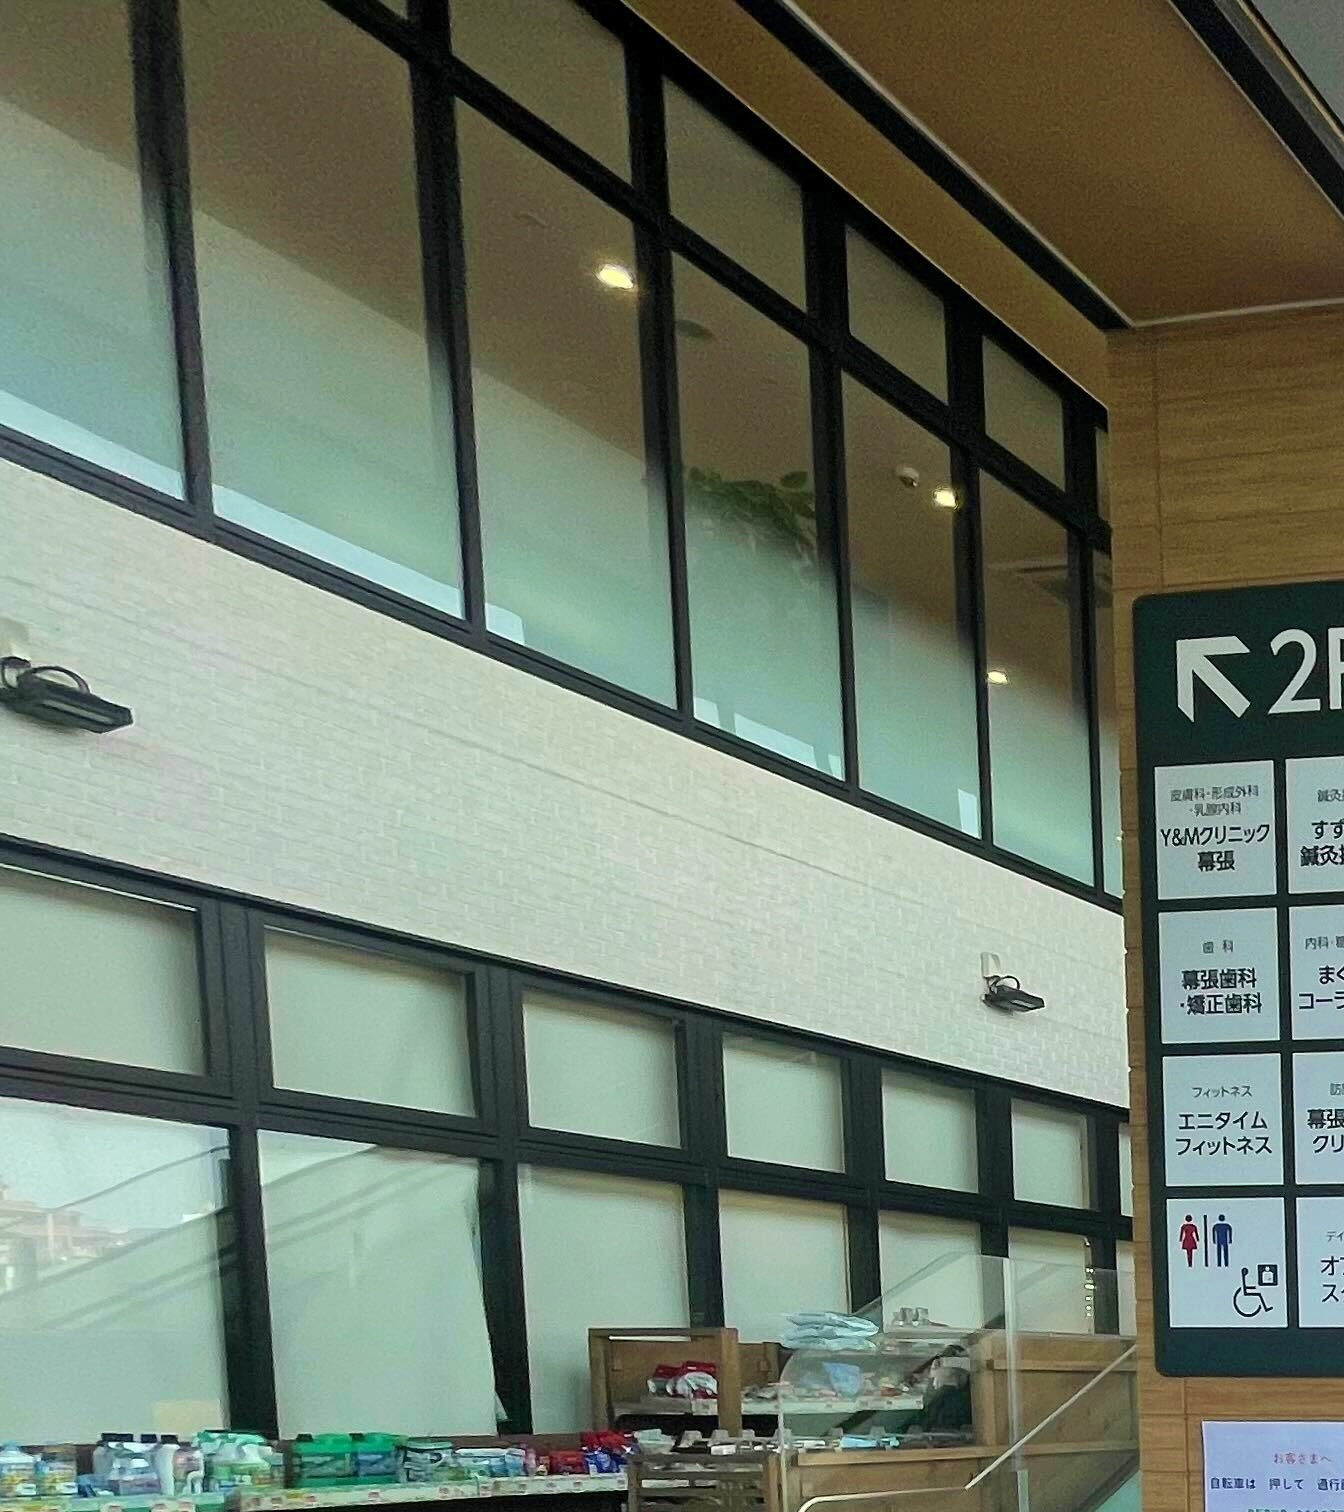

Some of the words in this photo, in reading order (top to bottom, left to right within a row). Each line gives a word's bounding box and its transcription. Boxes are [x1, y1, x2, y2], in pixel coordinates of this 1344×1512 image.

[1160, 824, 1271, 847] Y&Mクリニック
[1197, 850, 1236, 872] 幕張
[1181, 968, 1257, 990] 幕張歯科
[1192, 1085, 1253, 1099] フィットネス
[1178, 1110, 1268, 1131] エニタイム
[1175, 1136, 1273, 1156] フィットネス
[1210, 1476, 1256, 1490] 自転車は
[1269, 1477, 1305, 1491] 押して
